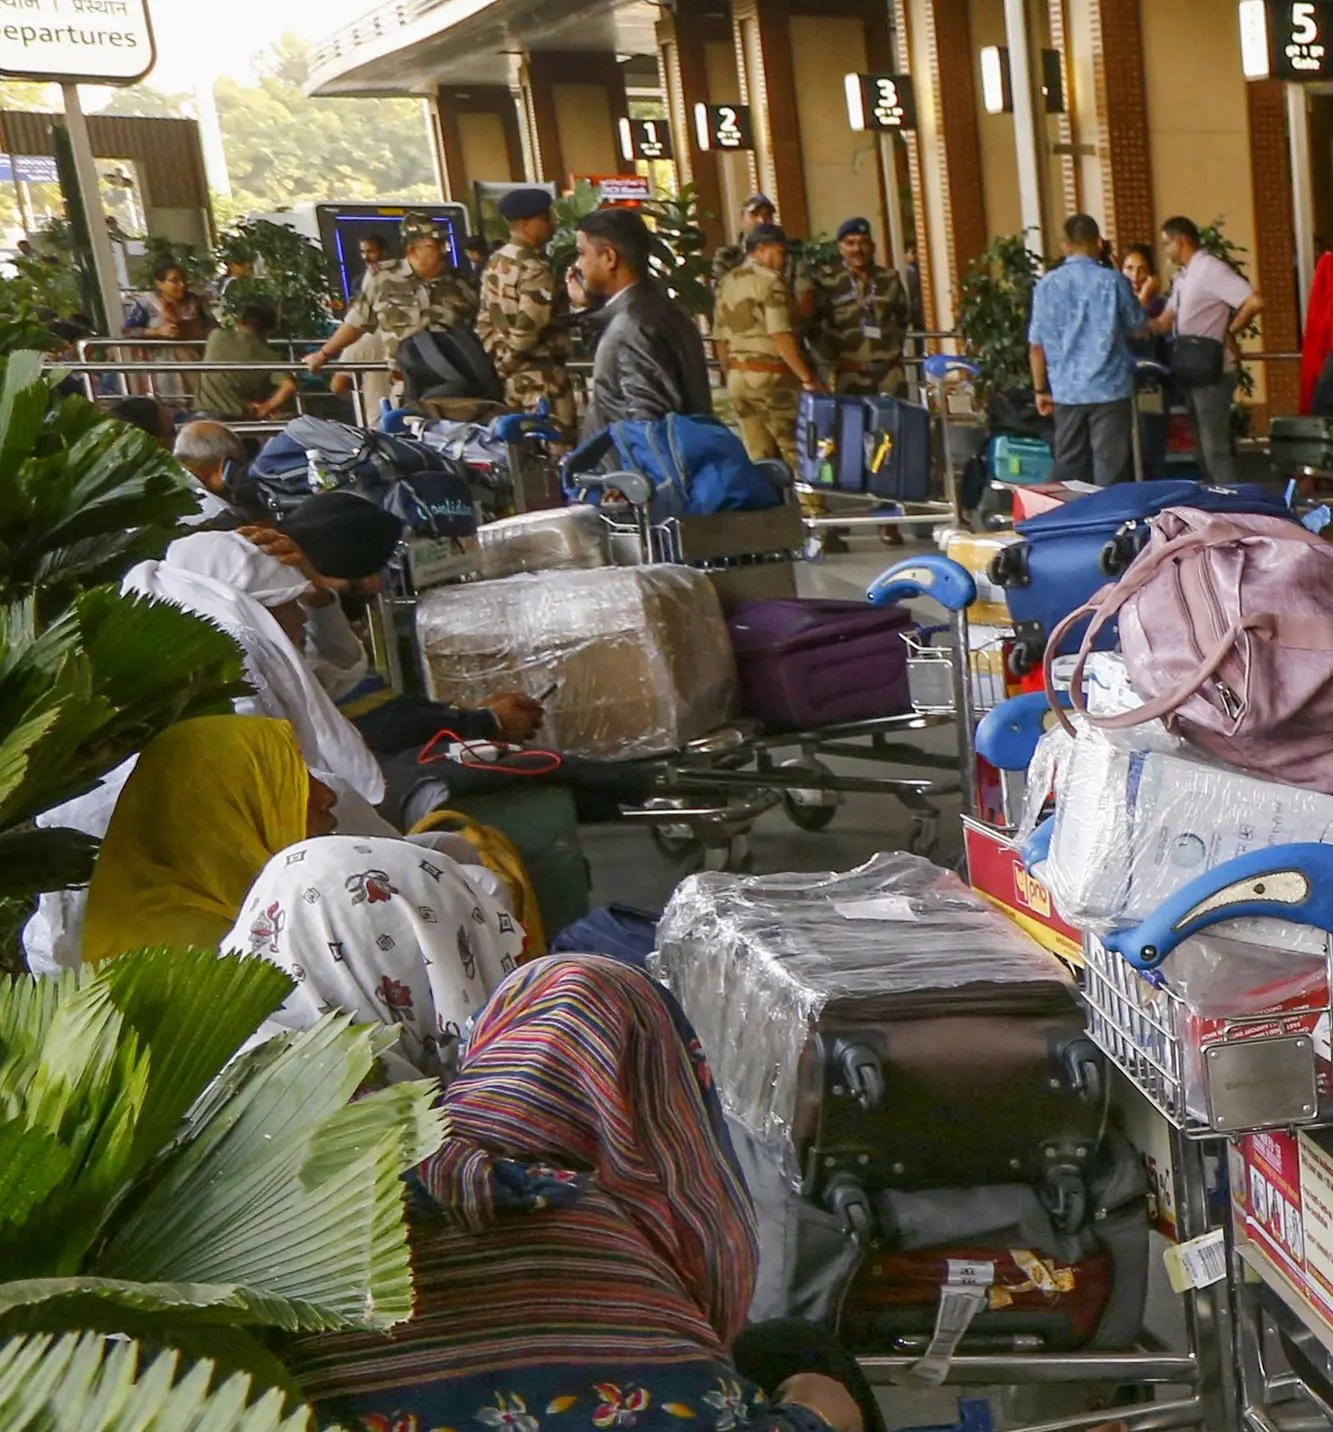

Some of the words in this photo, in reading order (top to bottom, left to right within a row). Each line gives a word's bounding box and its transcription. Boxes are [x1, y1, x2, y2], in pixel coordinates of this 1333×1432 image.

[0, 24, 137, 47] epartures
[1291, 3, 1318, 44] 5
[876, 79, 897, 107] 3
[718, 107, 738, 131] 2
[643, 121, 656, 143] 1
